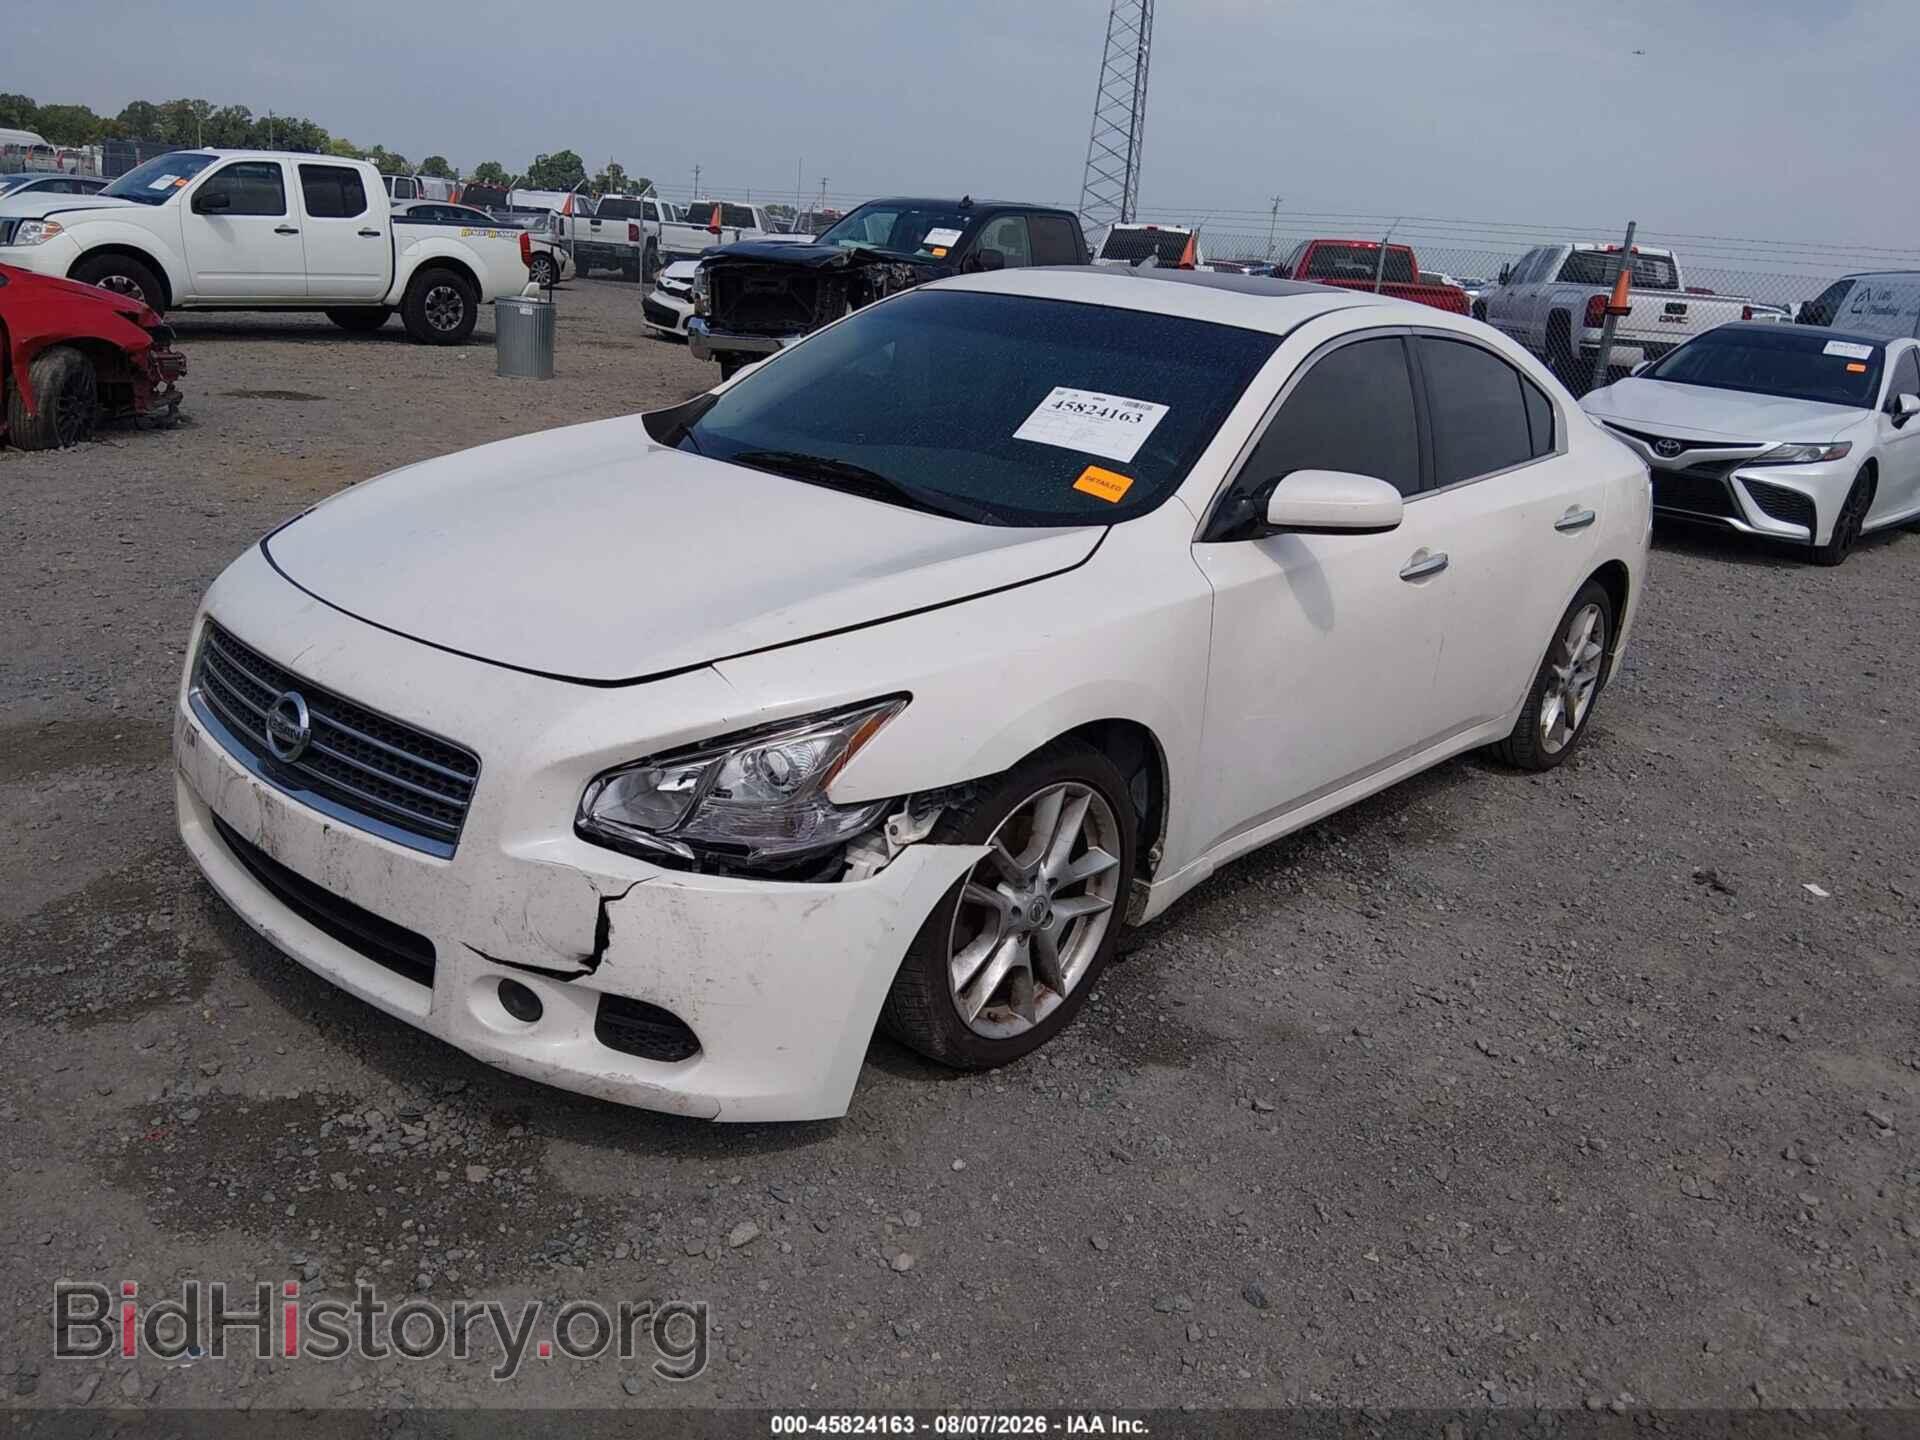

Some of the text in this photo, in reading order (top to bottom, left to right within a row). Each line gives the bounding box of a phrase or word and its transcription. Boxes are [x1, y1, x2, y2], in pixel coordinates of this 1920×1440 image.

[1658, 315, 1689, 324] GMC
[1051, 399, 1144, 424] 45824163
[1085, 475, 1122, 492] DETAILED
